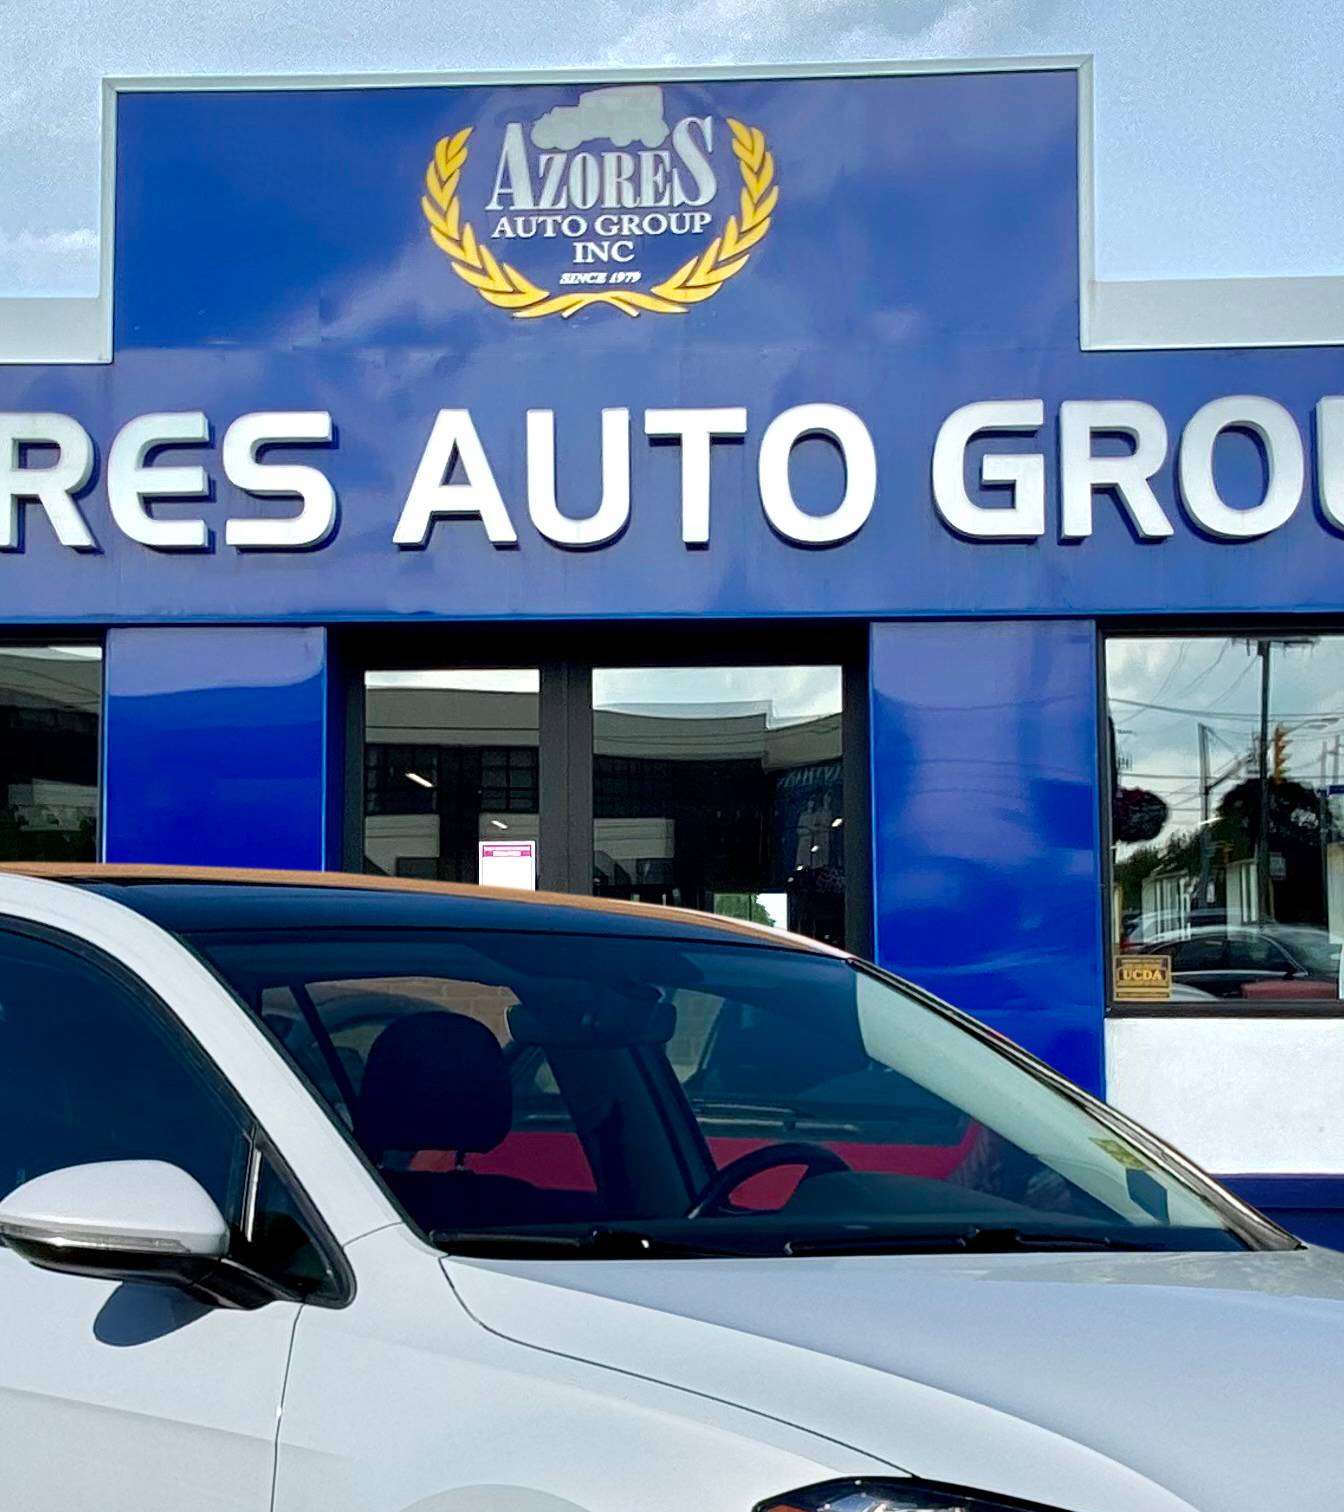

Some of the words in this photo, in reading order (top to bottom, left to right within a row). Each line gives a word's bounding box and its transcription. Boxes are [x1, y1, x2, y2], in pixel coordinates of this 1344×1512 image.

[485, 116, 717, 211] AZORES
[491, 215, 587, 239] AUTO
[595, 212, 712, 236] GROUP
[573, 241, 634, 264] INC
[560, 272, 607, 284] SINCE
[609, 271, 641, 283] 1979
[392, 402, 878, 548] AUTO
[1123, 969, 1161, 980] UCDA
